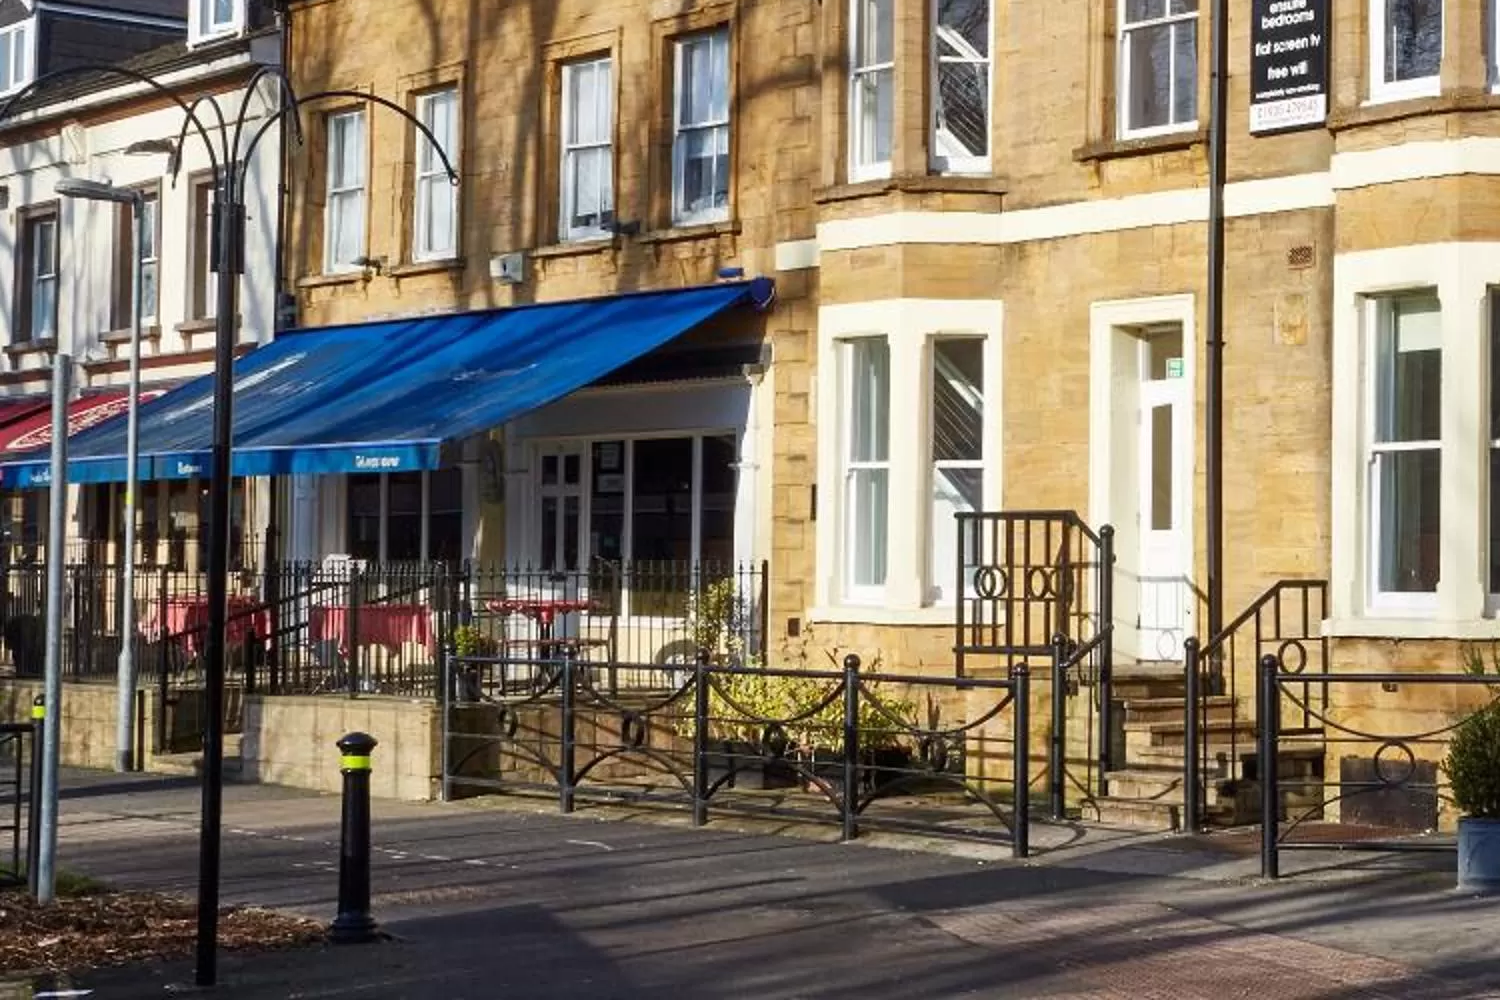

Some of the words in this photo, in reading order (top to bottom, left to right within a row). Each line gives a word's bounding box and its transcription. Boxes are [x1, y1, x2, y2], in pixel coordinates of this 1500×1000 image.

[1261, 9, 1315, 30] bedrooms
[1255, 41, 1272, 57] flat
[1273, 37, 1309, 54] screen
[1310, 33, 1321, 48] tv
[1267, 66, 1289, 80] free
